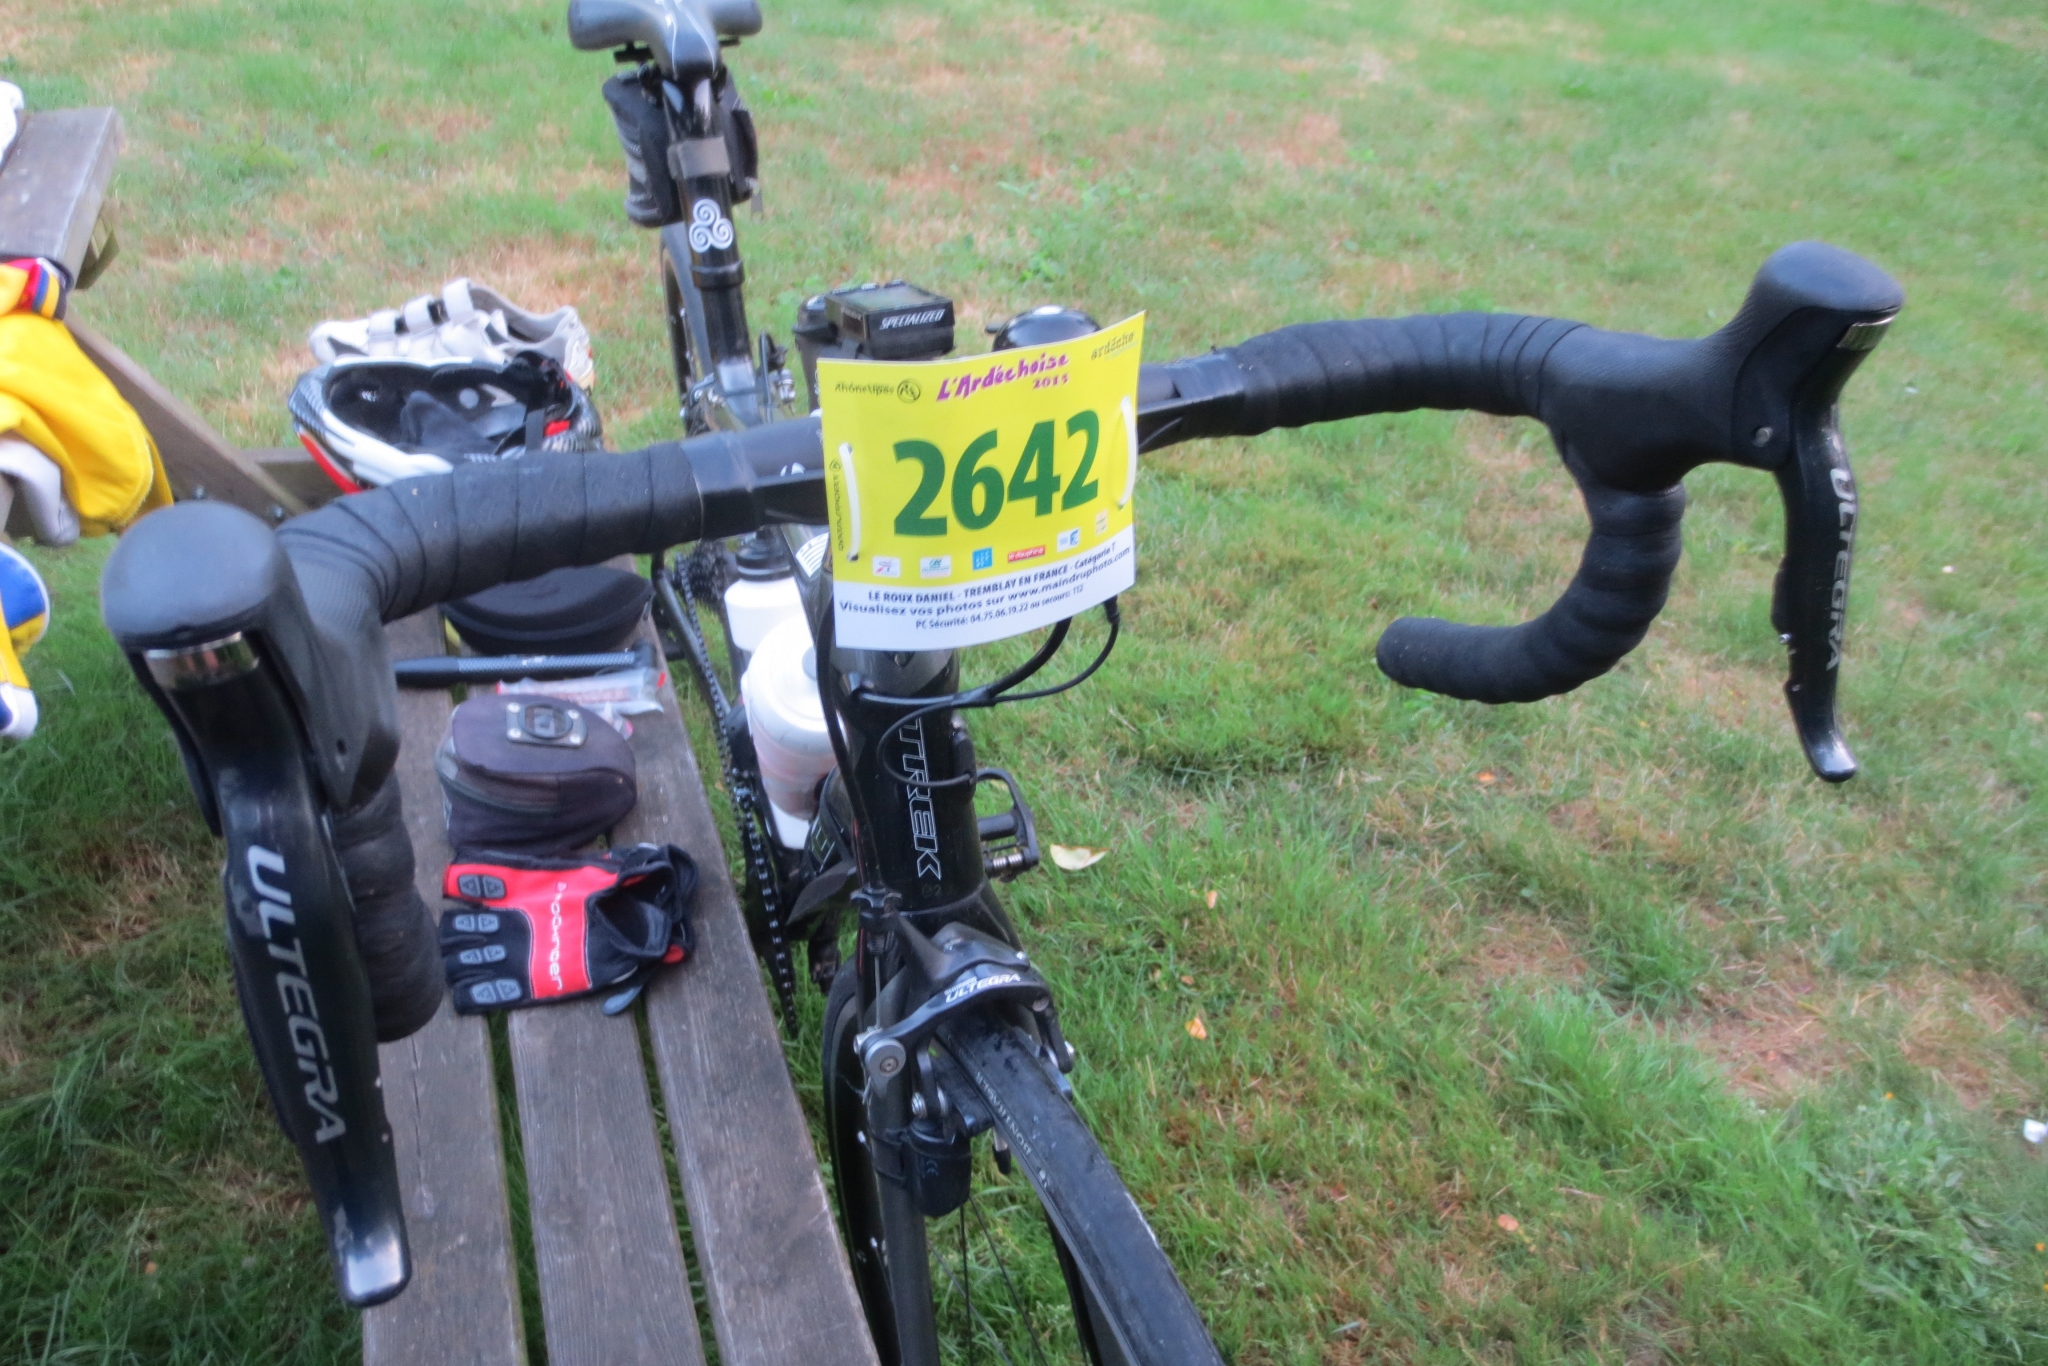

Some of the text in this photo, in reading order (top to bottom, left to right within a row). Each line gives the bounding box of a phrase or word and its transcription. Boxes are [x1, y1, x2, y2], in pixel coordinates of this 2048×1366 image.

[879, 309, 945, 330] SPECIALIZED
[936, 352, 1069, 402] L'Ardéchoise
[1032, 373, 1069, 390] 2015
[892, 408, 1100, 538] 2642
[839, 600, 906, 616] Visualisez
[910, 606, 933, 616] vos
[936, 597, 982, 616] photos
[985, 596, 1005, 608] sur
[1008, 546, 1131, 602] www.maindruphoto.com
[868, 589, 881, 601] LE
[883, 591, 913, 604] ROUX
[915, 591, 955, 604] DANIEL
[963, 577, 1016, 600] TREMBLAY
[1018, 574, 1031, 586] EN
[1033, 564, 1068, 583] FRANCE
[1074, 547, 1110, 571] Catégorie
[1110, 541, 1117, 552] T
[1826, 468, 1856, 671] ULTEGRA
[915, 619, 927, 630] PC
[929, 614, 968, 629] Sécurité:
[970, 602, 1028, 624] 04.75.06.19.22
[1030, 600, 1040, 609] ou
[1073, 583, 1084, 595] 112
[899, 715, 942, 881] TREK
[247, 844, 346, 1145] ULTEGRA
[945, 973, 1022, 1003] ULTEGRA
